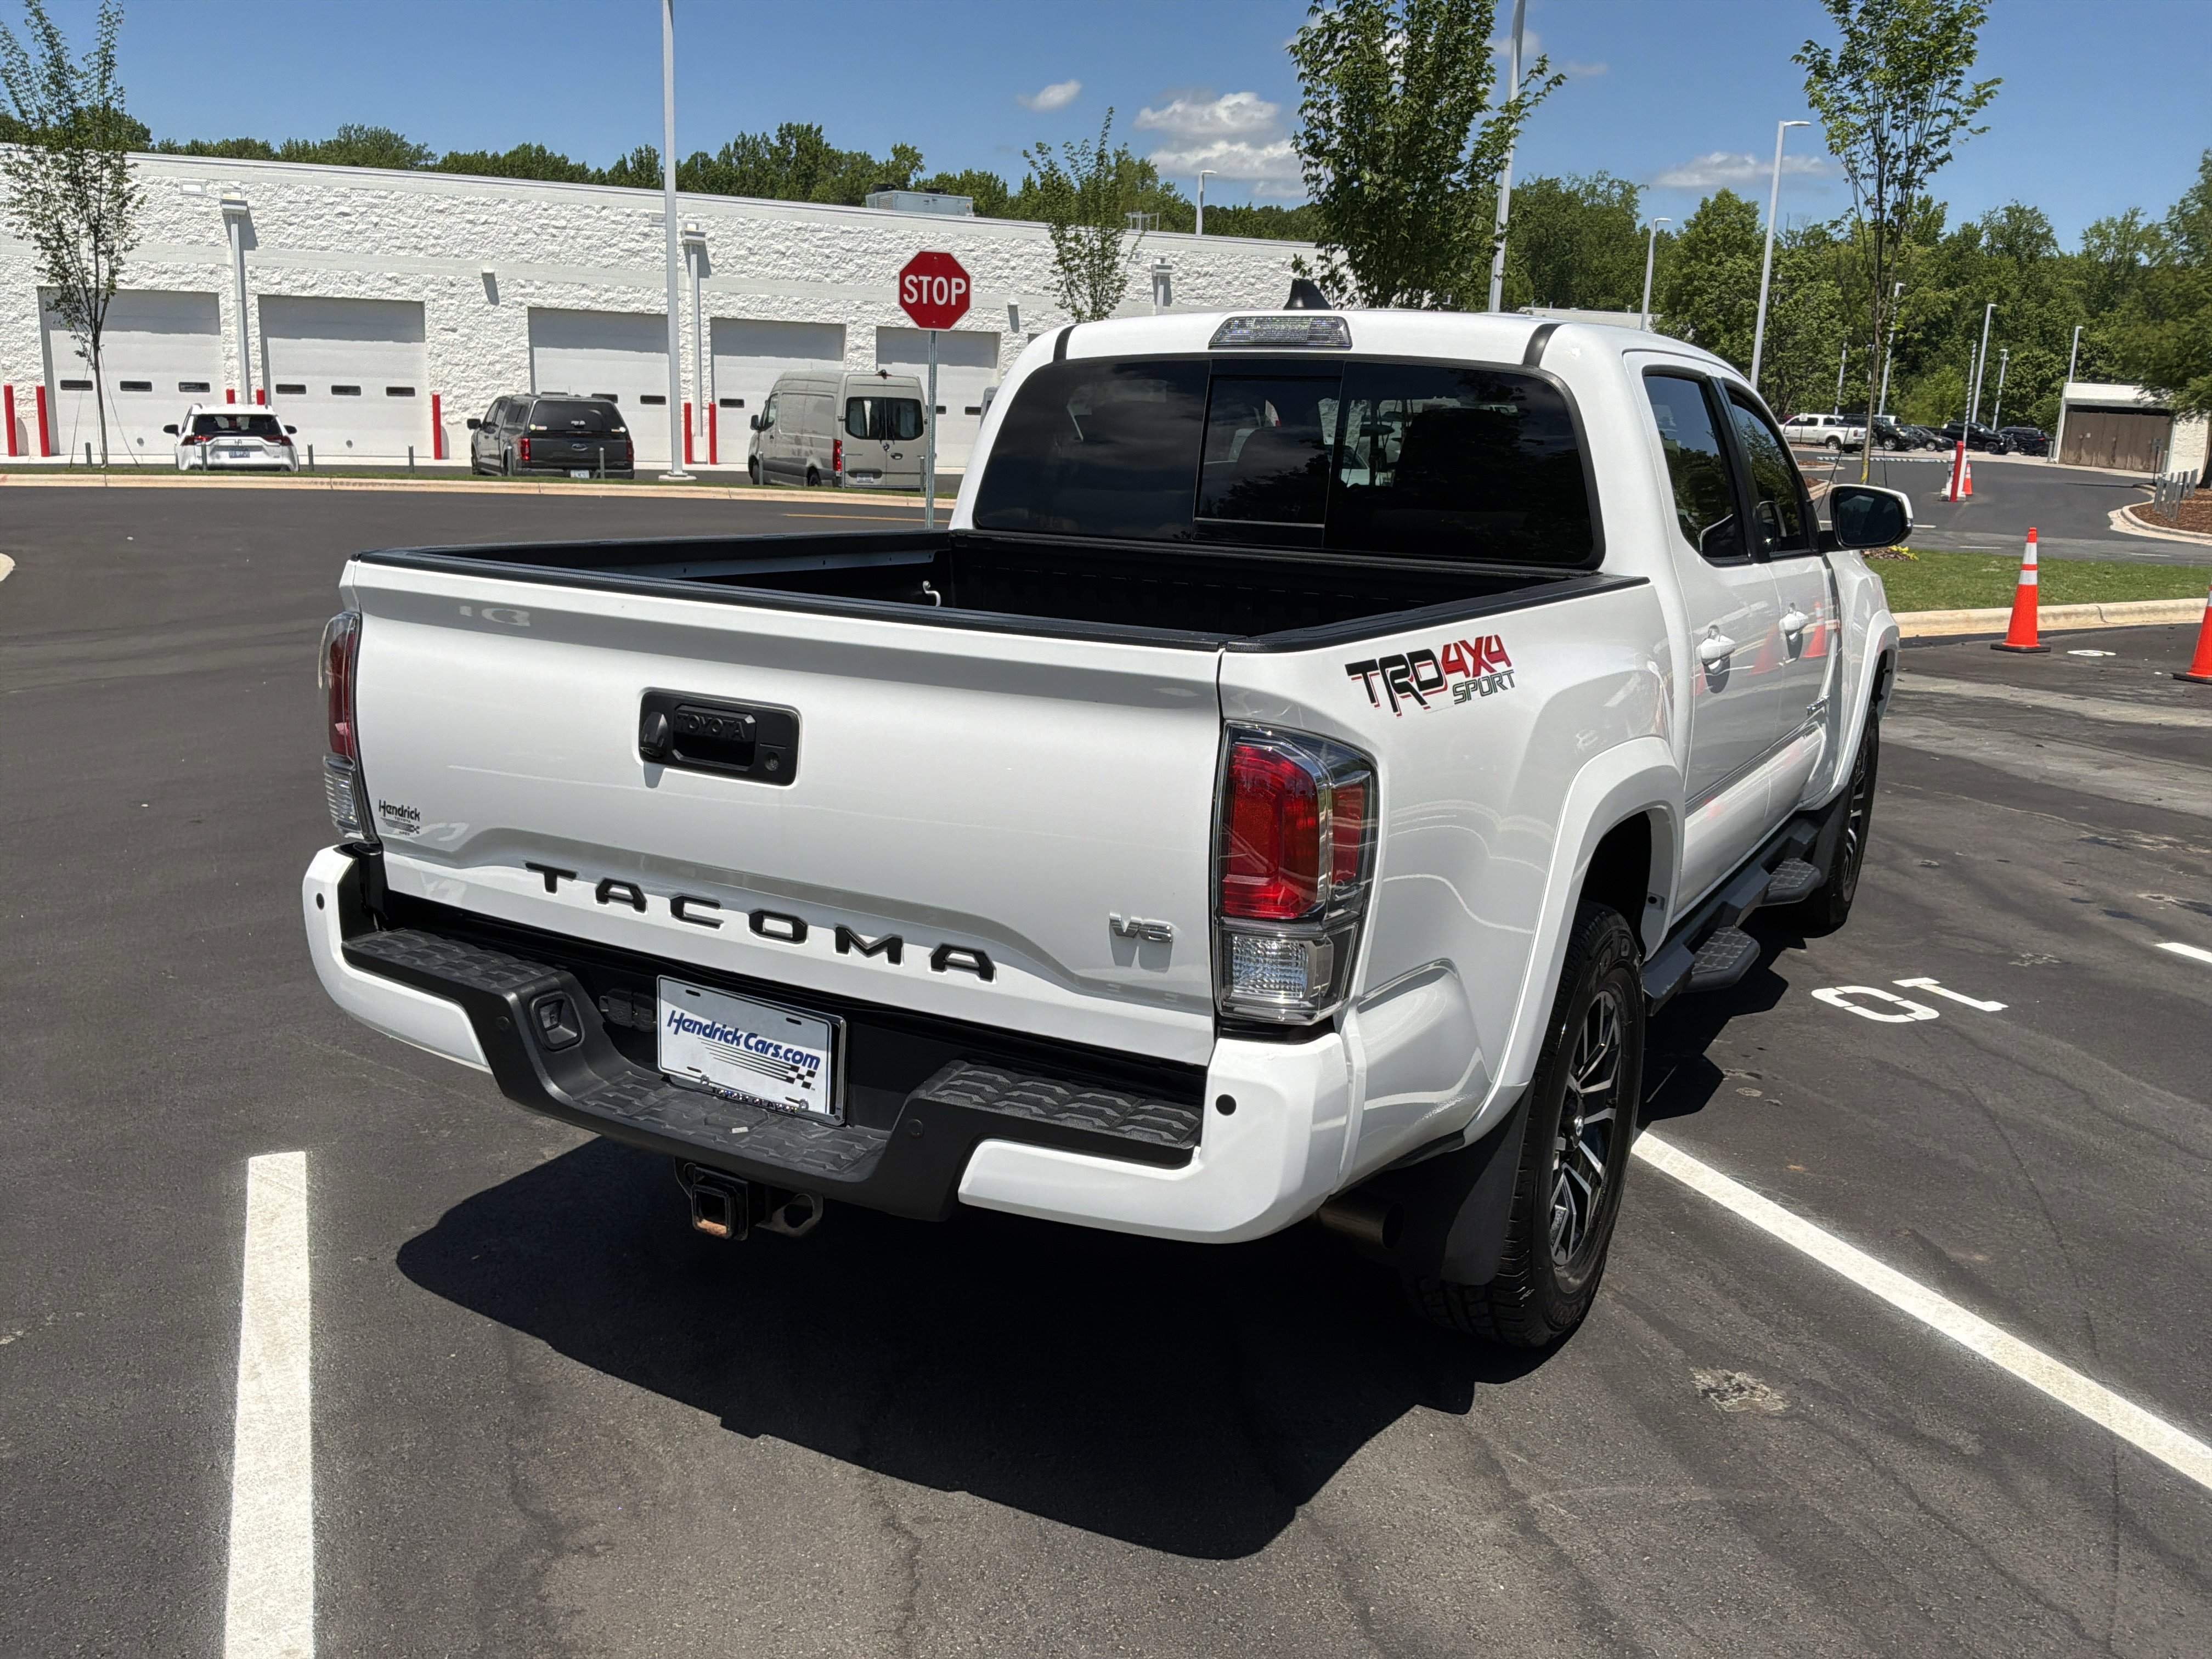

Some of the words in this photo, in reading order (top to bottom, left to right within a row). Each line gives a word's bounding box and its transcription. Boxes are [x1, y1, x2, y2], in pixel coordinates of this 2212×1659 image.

[903, 275, 966, 306] STOP
[1345, 648, 1448, 718] TRD
[1452, 669, 1515, 705] SPORT
[676, 713, 746, 739] TOYOTA
[379, 799, 421, 822] Hendrick
[524, 861, 997, 983] TACOMA
[1109, 913, 1173, 943] V6
